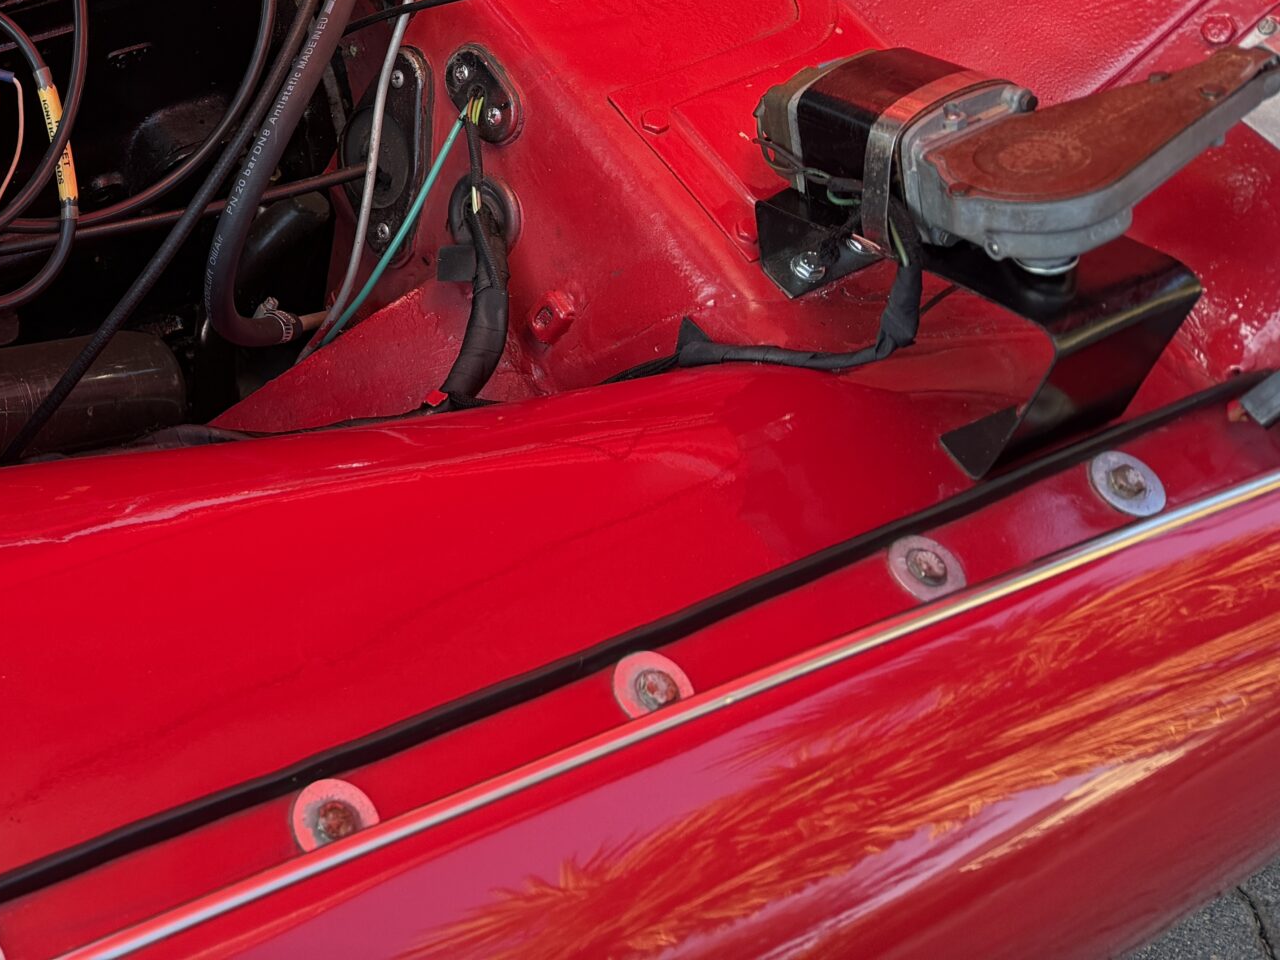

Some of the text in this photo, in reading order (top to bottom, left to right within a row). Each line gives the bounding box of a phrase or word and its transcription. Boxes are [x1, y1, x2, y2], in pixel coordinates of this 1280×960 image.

[41, 100, 55, 139] IGNITIO
[226, 196, 238, 215] PN
[235, 179, 246, 196] 20
[243, 155, 257, 178] bar
[269, 71, 302, 125] Antistatic
[297, 40, 318, 70] MADE
[319, 17, 329, 31] EU
